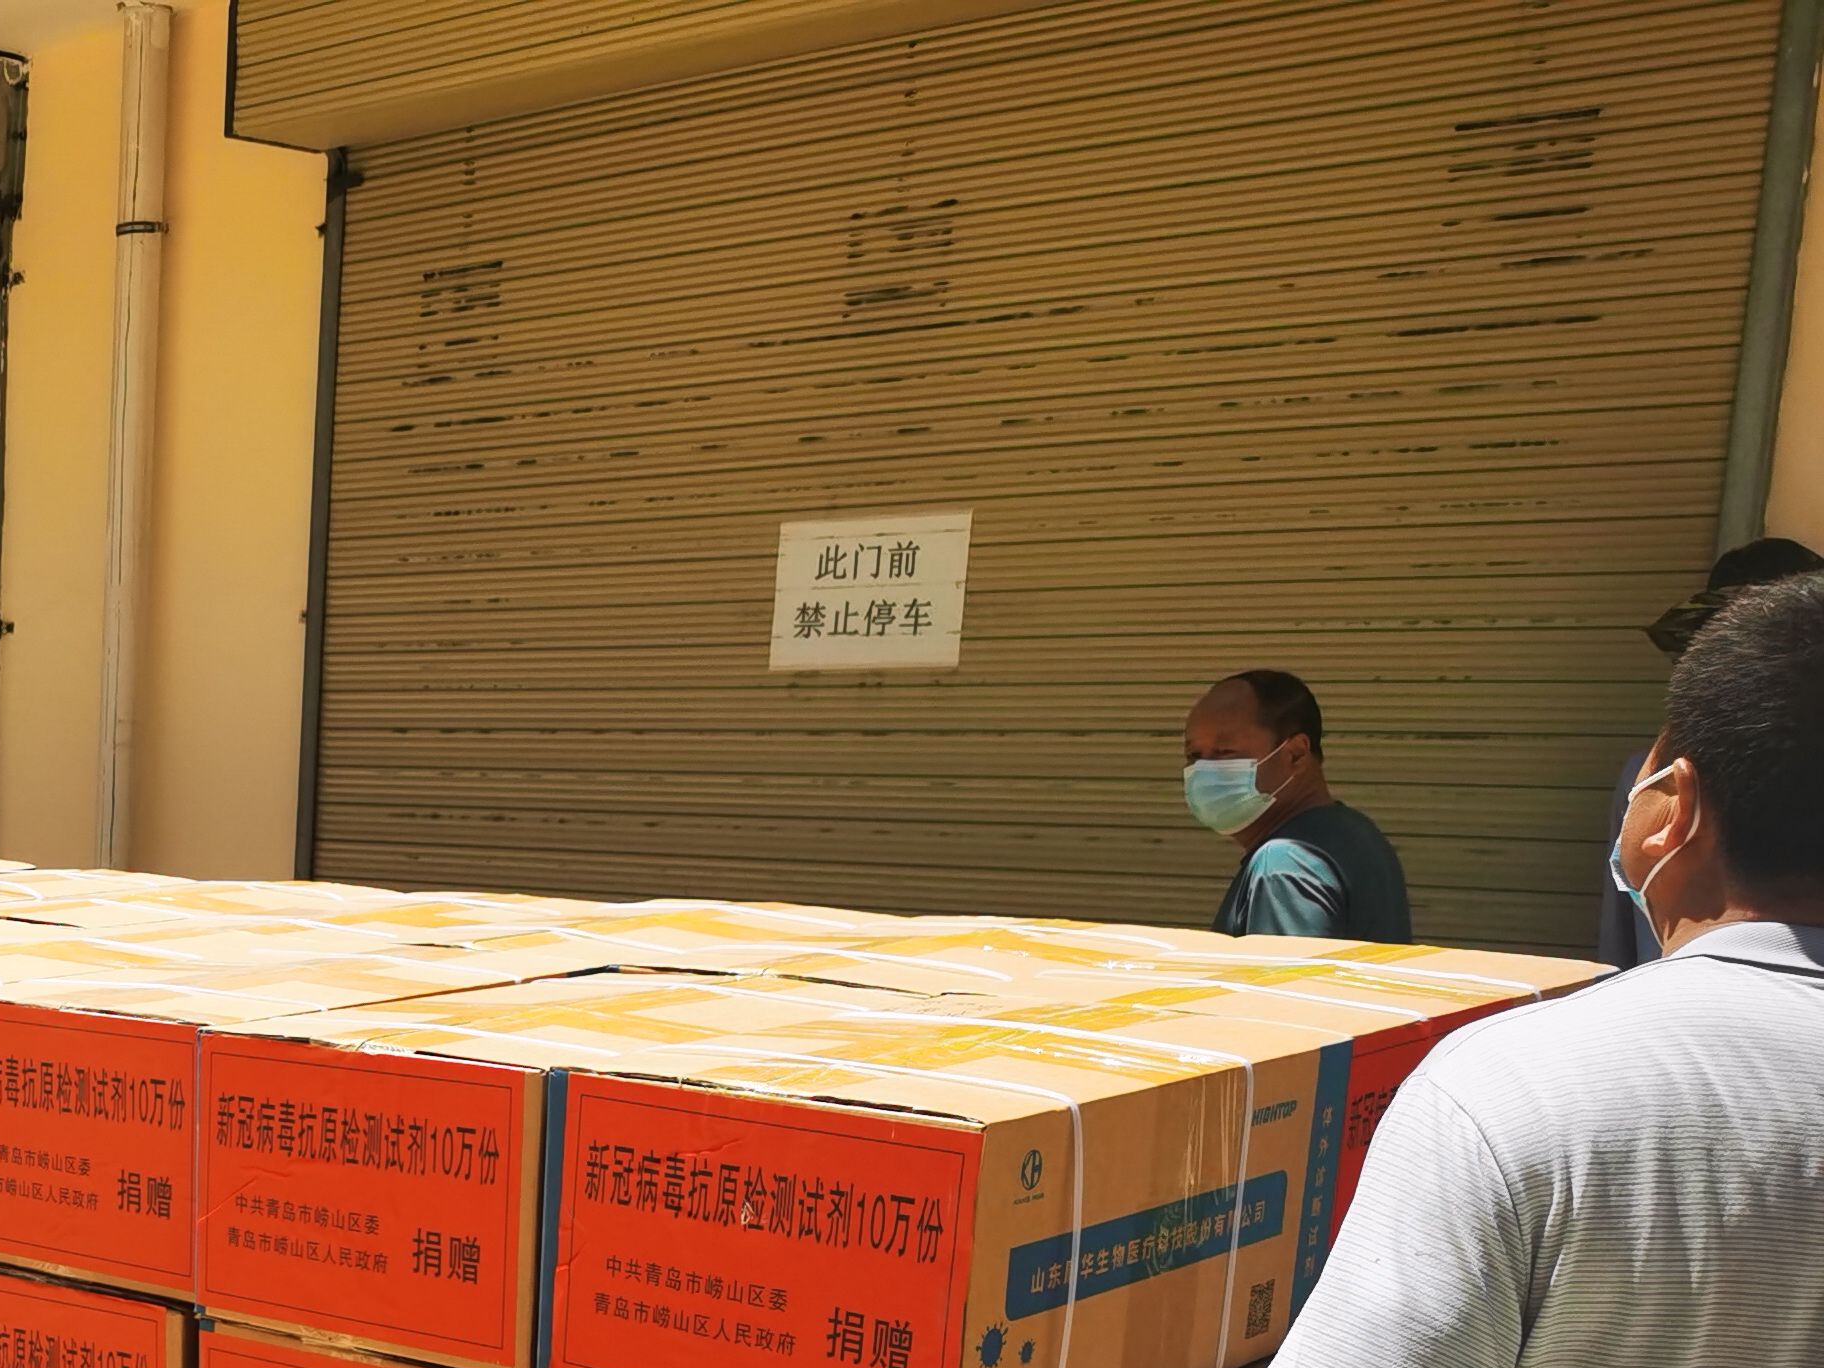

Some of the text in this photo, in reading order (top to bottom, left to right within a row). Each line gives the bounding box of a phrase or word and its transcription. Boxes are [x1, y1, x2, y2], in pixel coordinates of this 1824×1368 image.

[814, 540, 921, 581] 此门前
[792, 598, 933, 639] 禁止停车
[215, 1091, 499, 1185] 新冠病毒抗原检测试剂10万份
[116, 1168, 172, 1221] 捐赠
[234, 1193, 380, 1235] 中共青岛市崂山区委
[584, 1139, 943, 1263] 新冠病毒抗原检测试剂10万份
[226, 1225, 388, 1274] 青岛市崂山区人民政府
[411, 1226, 480, 1287] 捐赠
[605, 1255, 787, 1312] 中共青岛市崂山区委
[594, 1291, 796, 1356] 青岛市崂山区人民政府
